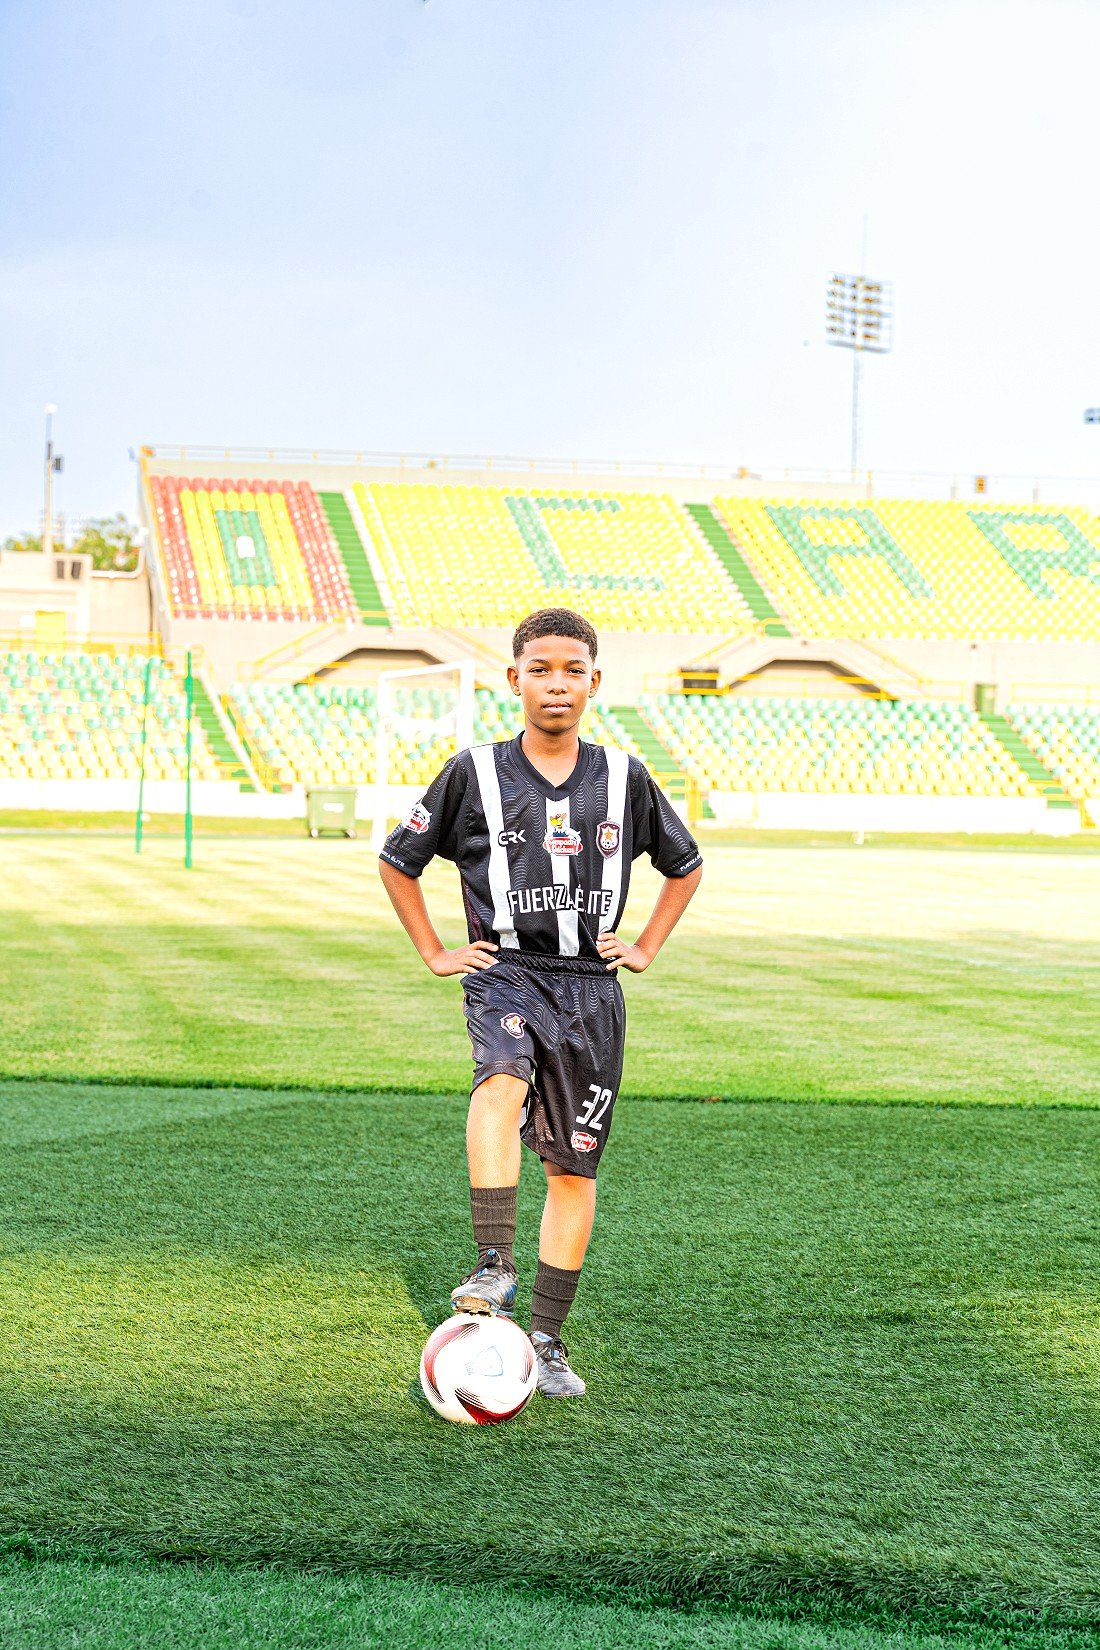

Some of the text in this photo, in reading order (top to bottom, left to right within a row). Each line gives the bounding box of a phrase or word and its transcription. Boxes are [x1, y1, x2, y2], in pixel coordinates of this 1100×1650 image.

[498, 829, 527, 845] CRK
[507, 883, 612, 915] FUERZA ÉITE
[576, 1083, 613, 1131] 32
